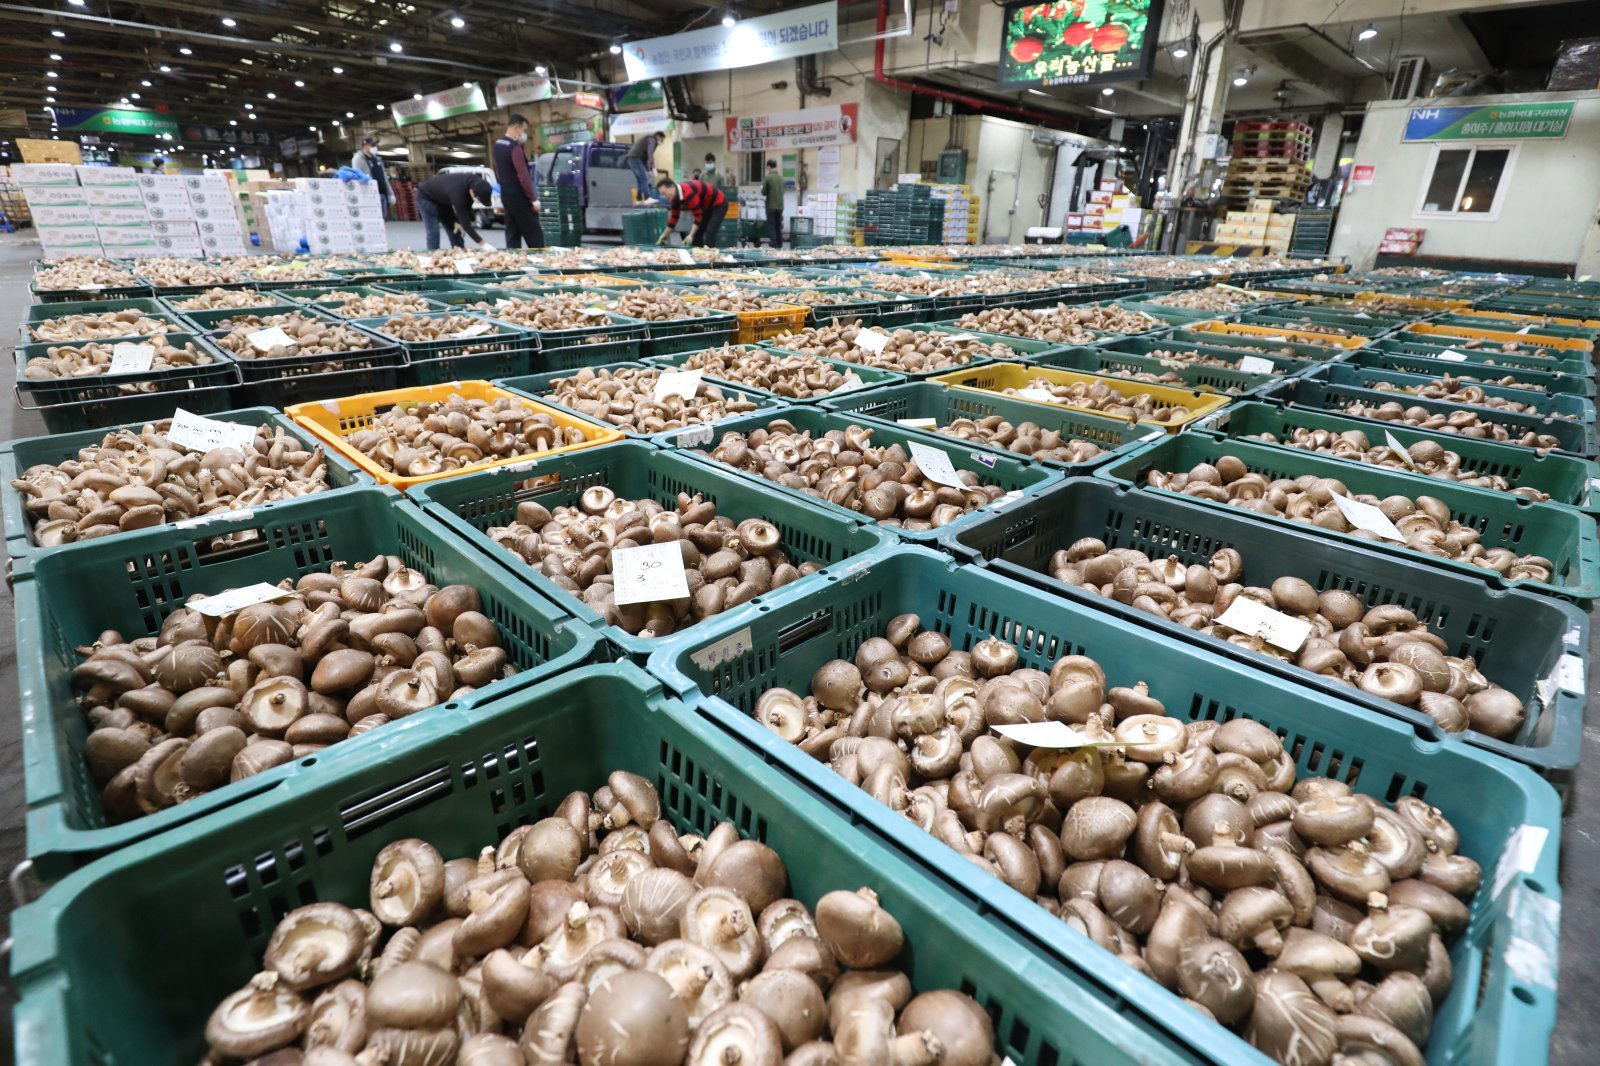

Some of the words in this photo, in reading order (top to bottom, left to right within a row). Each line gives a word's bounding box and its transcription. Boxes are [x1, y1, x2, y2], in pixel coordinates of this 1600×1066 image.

[779, 18, 829, 44] 되겠습니다
[1412, 109, 1440, 119] NH
[640, 561, 662, 570] 30
